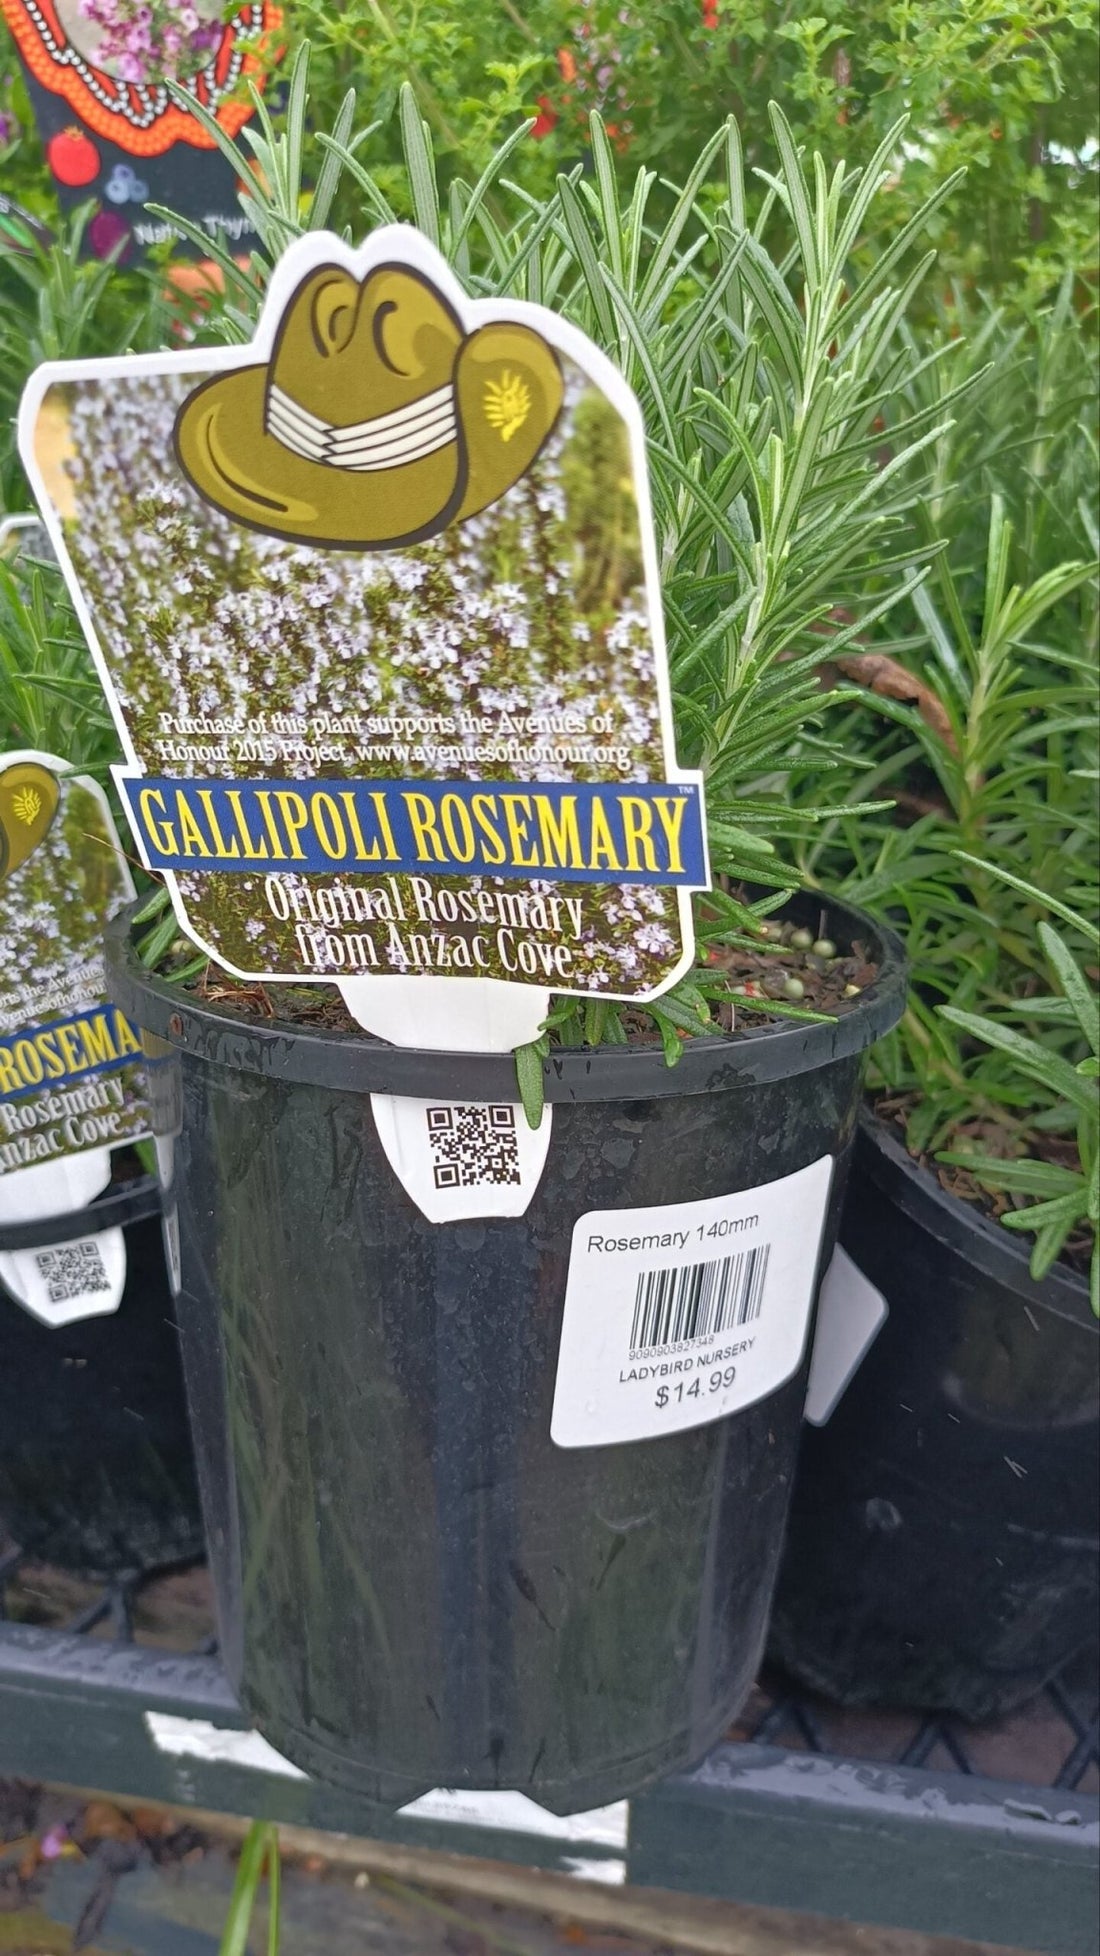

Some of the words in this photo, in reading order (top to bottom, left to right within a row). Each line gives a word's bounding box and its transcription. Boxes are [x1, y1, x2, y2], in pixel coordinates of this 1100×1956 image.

[158, 712, 246, 735] Purchase
[248, 712, 271, 735] of
[271, 711, 308, 734] this
[313, 711, 363, 741] plant
[367, 713, 456, 741] supports
[459, 711, 494, 734] the
[499, 711, 588, 734] Avenues
[592, 711, 615, 734] of
[157, 739, 231, 761] Honour
[232, 740, 278, 762] 2015
[359, 739, 632, 771] www.avenuesofhonour.org
[139, 788, 402, 862] GALLIPOLI
[401, 792, 688, 874] ROSEMARY
[264, 876, 402, 929] Original
[408, 876, 583, 941] Rosemary
[294, 923, 381, 968] from
[385, 921, 491, 968] Anzac
[496, 928, 577, 979] Cove
[0, 1077, 124, 1136] Rosemary
[65, 1112, 124, 1147] Cove
[588, 1230, 690, 1253] Rosemary
[696, 1214, 759, 1241] 140mm
[619, 1358, 694, 1383] LADYBIRD
[696, 1336, 757, 1368] NURSERY
[654, 1366, 737, 1408] $14.99
